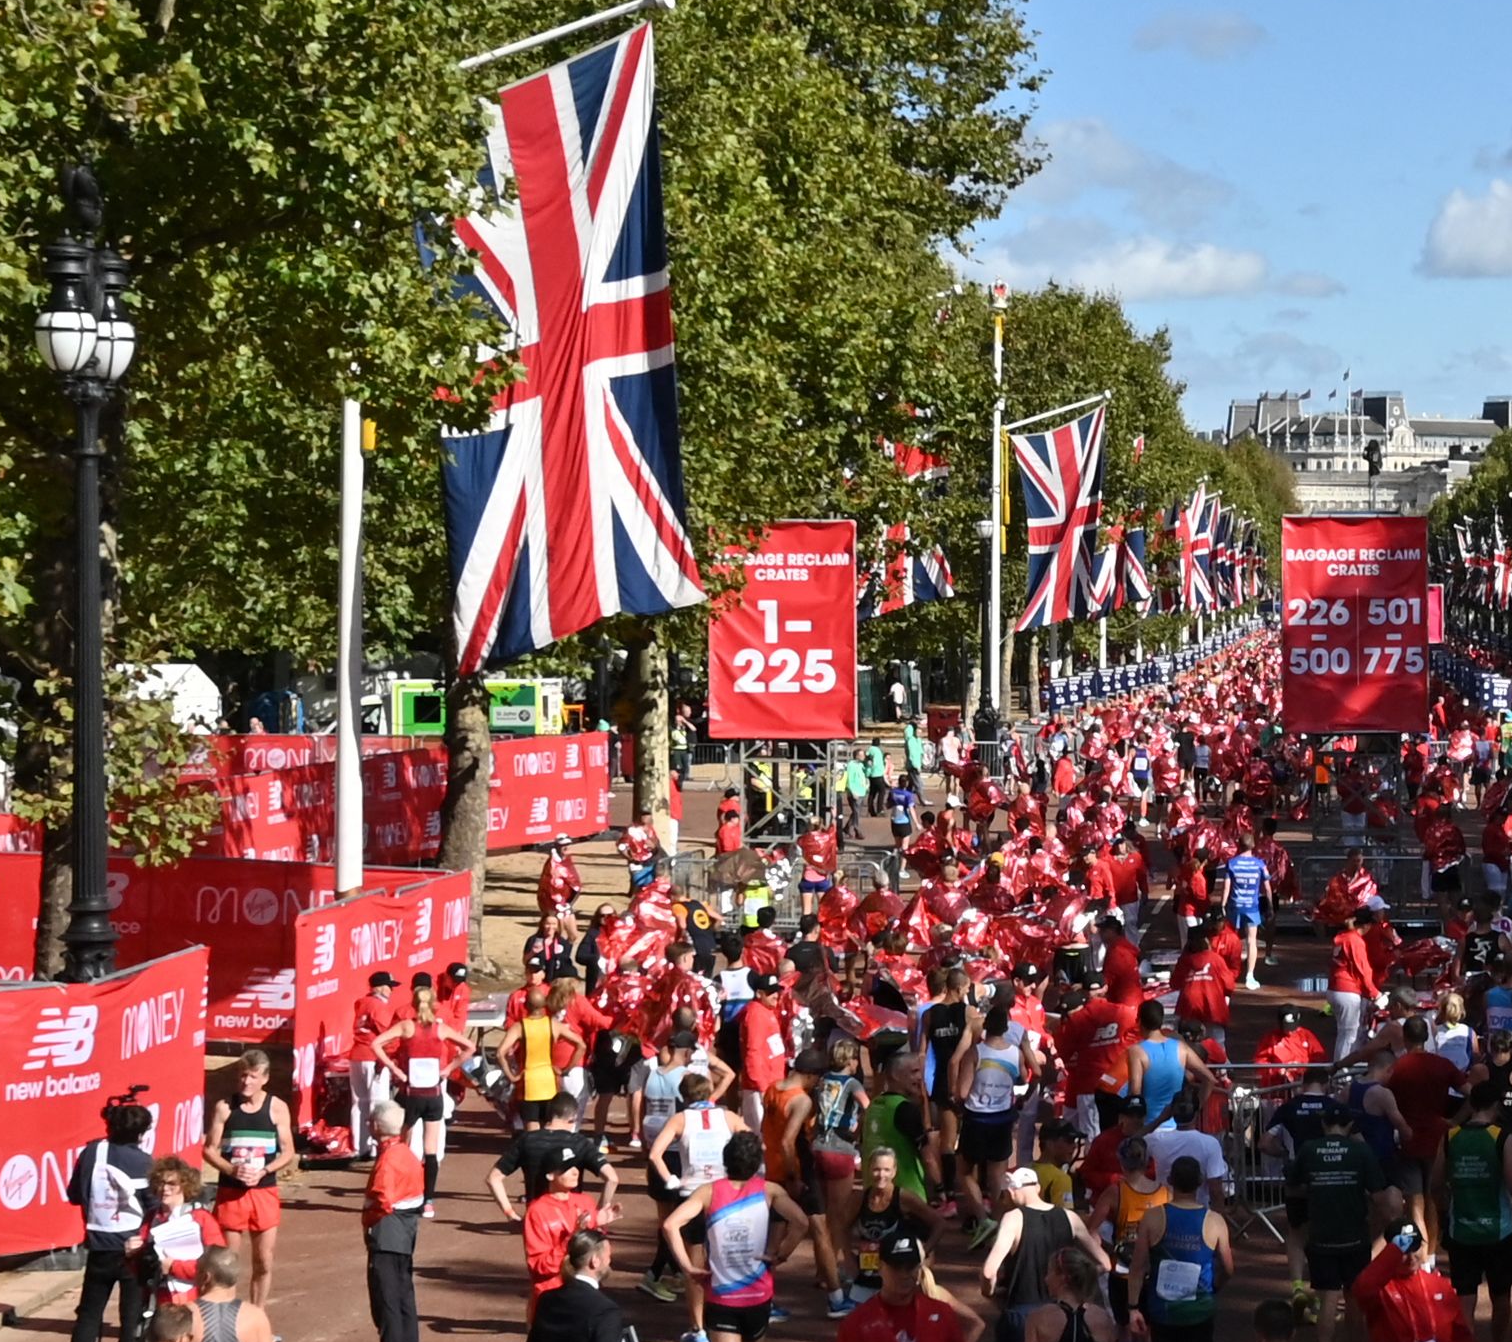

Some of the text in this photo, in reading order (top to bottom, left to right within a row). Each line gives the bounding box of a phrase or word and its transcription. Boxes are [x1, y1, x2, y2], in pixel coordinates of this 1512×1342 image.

[787, 553, 850, 566] RECLAIM
[1286, 548, 1421, 562] BAGGAGE RECLAIM
[754, 568, 809, 581] CRATES
[1327, 564, 1380, 576] CRATES
[1288, 598, 1350, 626] 226
[1367, 597, 1421, 626] 501
[732, 647, 837, 694] 225
[1289, 647, 1350, 675] 500
[1363, 646, 1425, 675] 775
[120, 987, 185, 1060] MONEY
[214, 1014, 248, 1029] new
[5, 1071, 100, 1102] new balance
